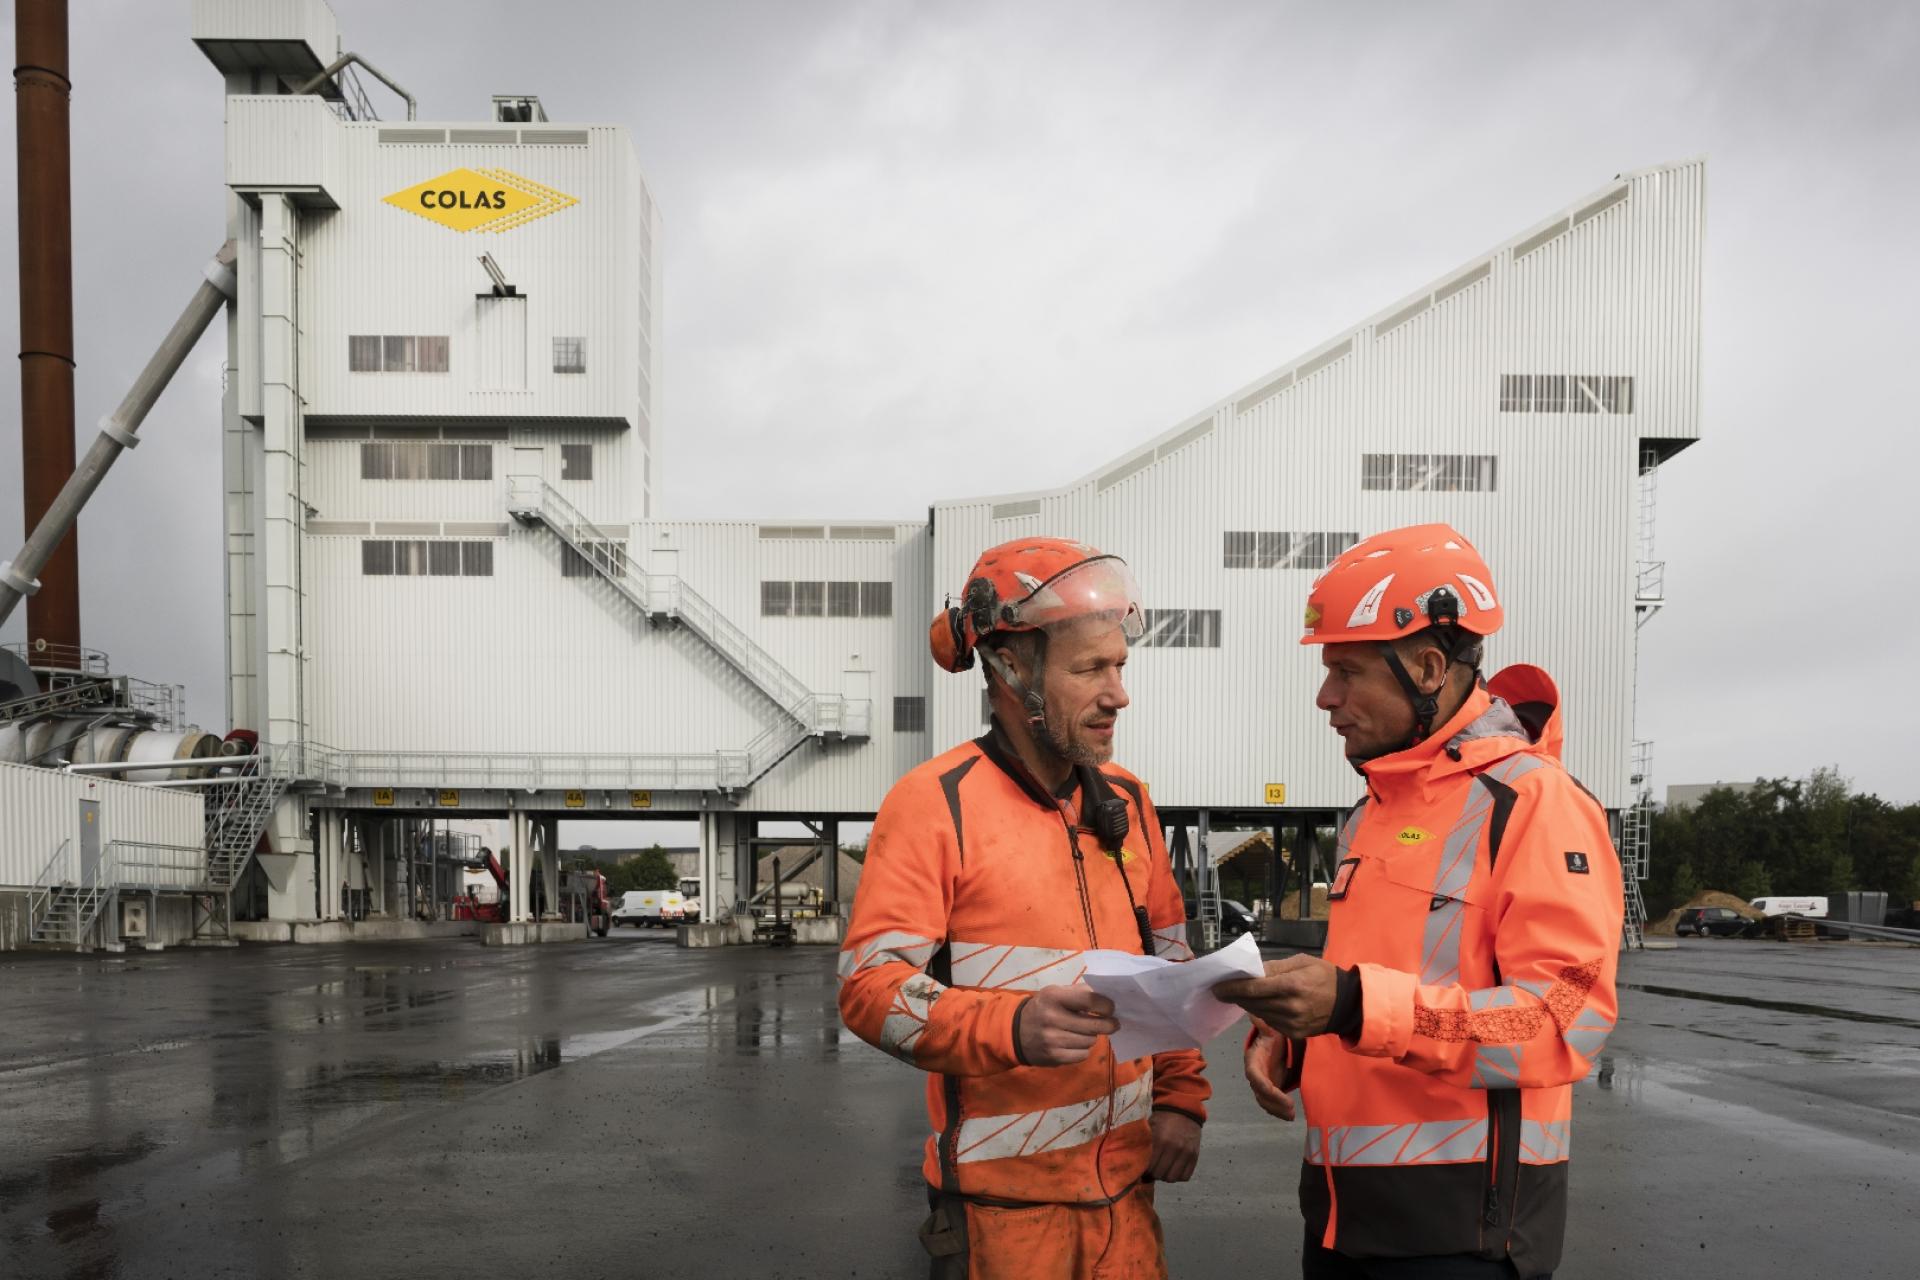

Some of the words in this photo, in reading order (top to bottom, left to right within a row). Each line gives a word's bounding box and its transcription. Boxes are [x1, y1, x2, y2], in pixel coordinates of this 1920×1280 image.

[420, 190, 506, 209] COLAS
[377, 791, 390, 800] 1A
[1270, 789, 1281, 799] 13
[1398, 831, 1421, 840] OLAS
